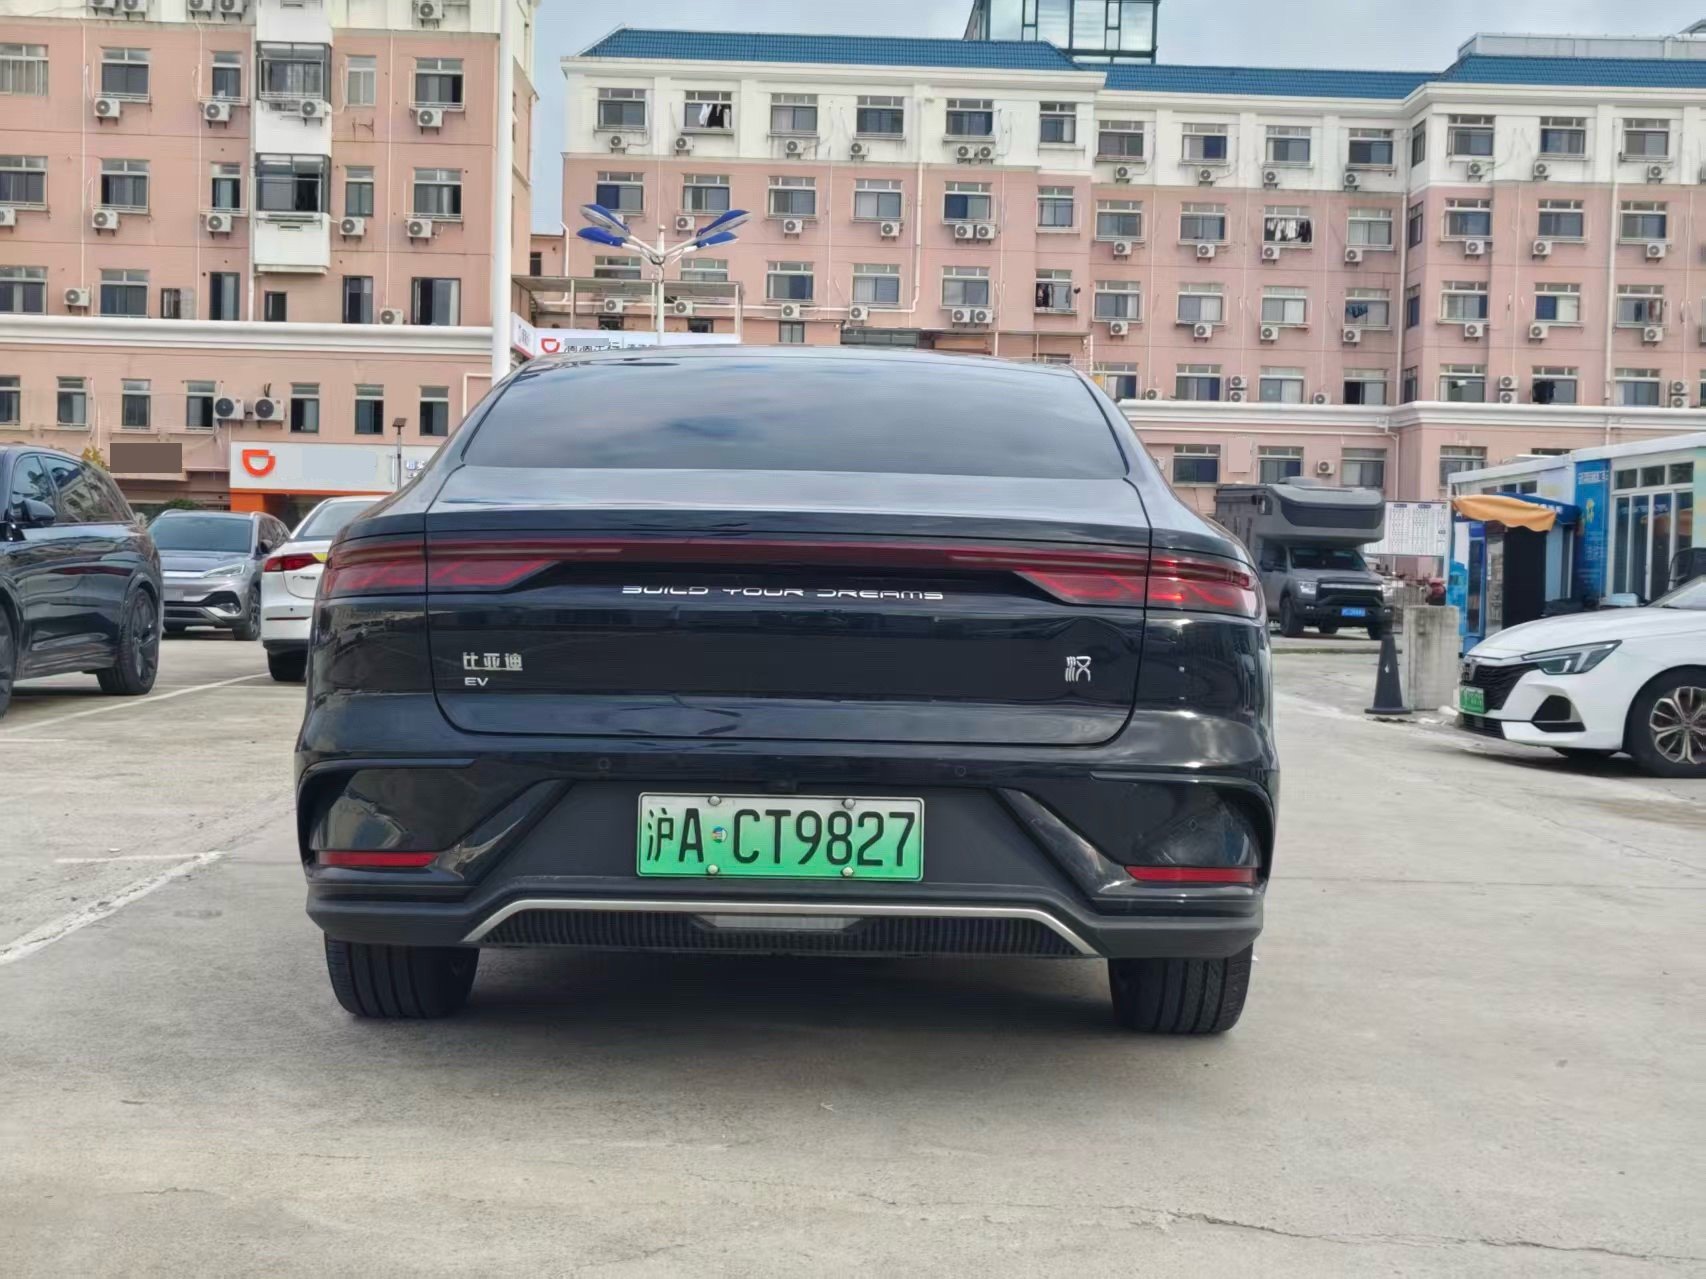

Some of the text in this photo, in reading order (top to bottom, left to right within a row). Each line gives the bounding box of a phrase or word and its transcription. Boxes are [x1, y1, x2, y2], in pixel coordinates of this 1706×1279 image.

[622, 585, 944, 600] BUILD YOUR DREAMS
[463, 652, 523, 671] 比亚迪
[464, 677, 489, 686] EV
